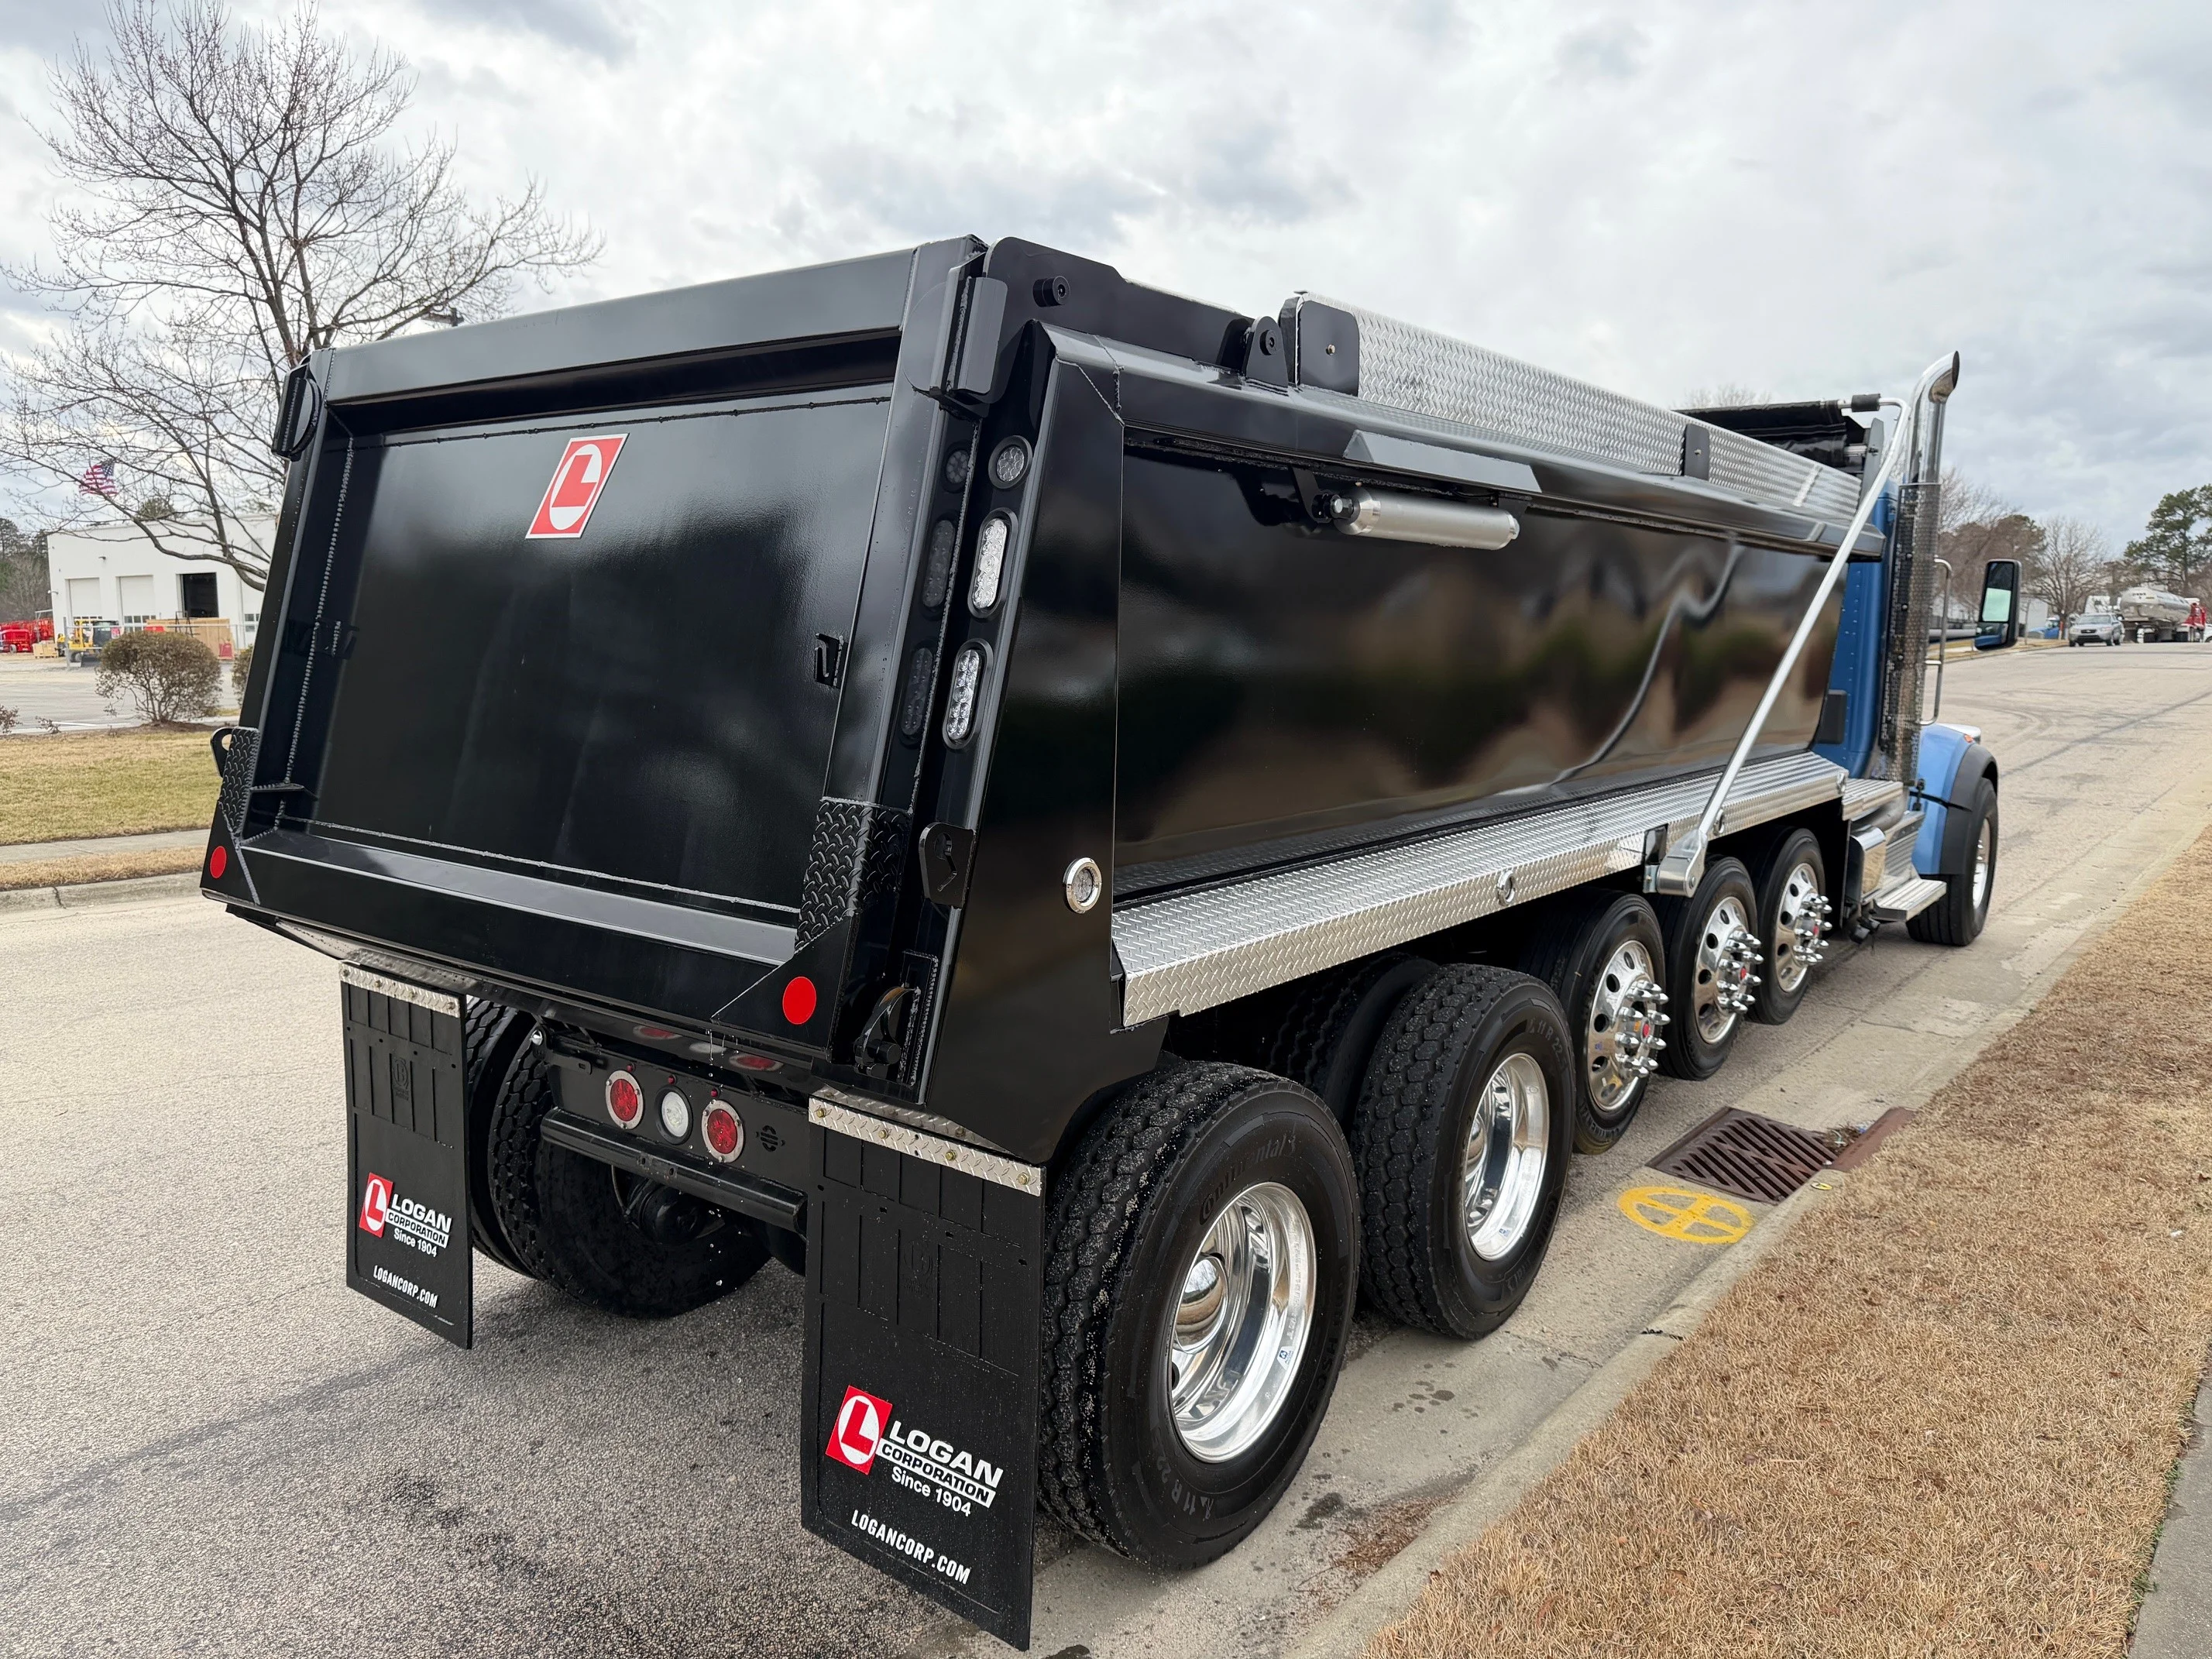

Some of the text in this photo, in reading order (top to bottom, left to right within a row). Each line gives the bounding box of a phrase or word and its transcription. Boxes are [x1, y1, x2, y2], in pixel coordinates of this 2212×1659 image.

[387, 1210, 447, 1247] CORPORATION
[391, 1194, 452, 1233] LOGAN
[393, 1228, 438, 1258] Since 1904
[373, 1265, 439, 1309] LOGANCORP.COM
[881, 1442, 991, 1505] CORPORATION
[889, 1420, 1004, 1489] LOGAN
[891, 1466, 971, 1517] Since 1904
[851, 1510, 972, 1585] LOGANCORP.COM
